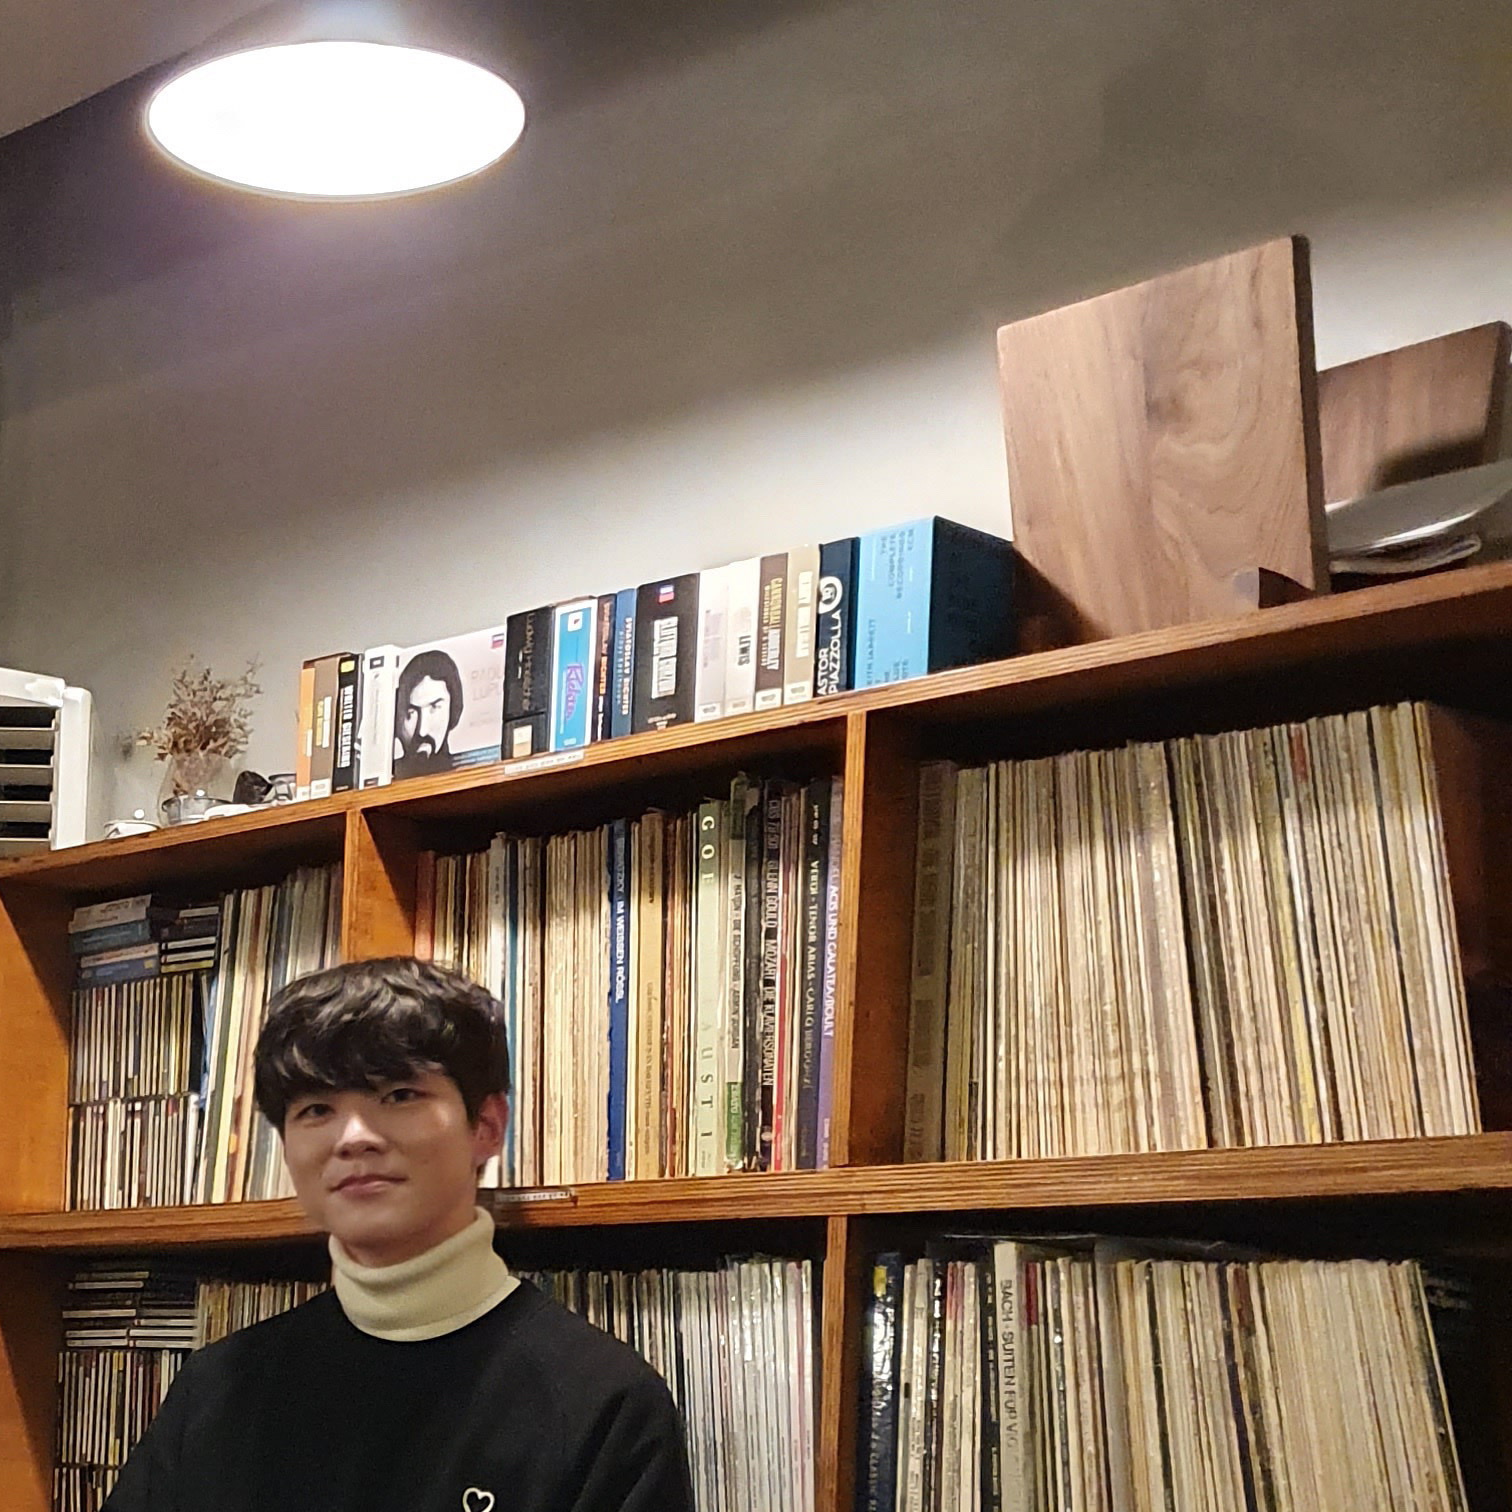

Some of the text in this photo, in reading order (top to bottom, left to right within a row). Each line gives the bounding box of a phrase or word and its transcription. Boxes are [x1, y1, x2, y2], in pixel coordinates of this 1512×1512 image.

[737, 634, 752, 667] LEWIS
[827, 608, 843, 695] PIAZZOLLA
[816, 647, 830, 696] ASTOR
[766, 860, 779, 893] GLENN
[809, 860, 821, 895] VERDI
[616, 900, 624, 915] IM
[765, 895, 778, 928] GOULD
[808, 903, 819, 942] TENOR
[615, 916, 625, 964] WEISSEN
[828, 914, 838, 940] UND
[764, 939, 778, 980] MOZART
[806, 945, 817, 979] ARIAS
[614, 966, 626, 1004] RÖSSL
[763, 986, 776, 1001] DIE
[761, 1004, 775, 1086] KLAVIERSONATEN
[1000, 1279, 1014, 1322] BACH
[1001, 1331, 1017, 1386] SUITEN
